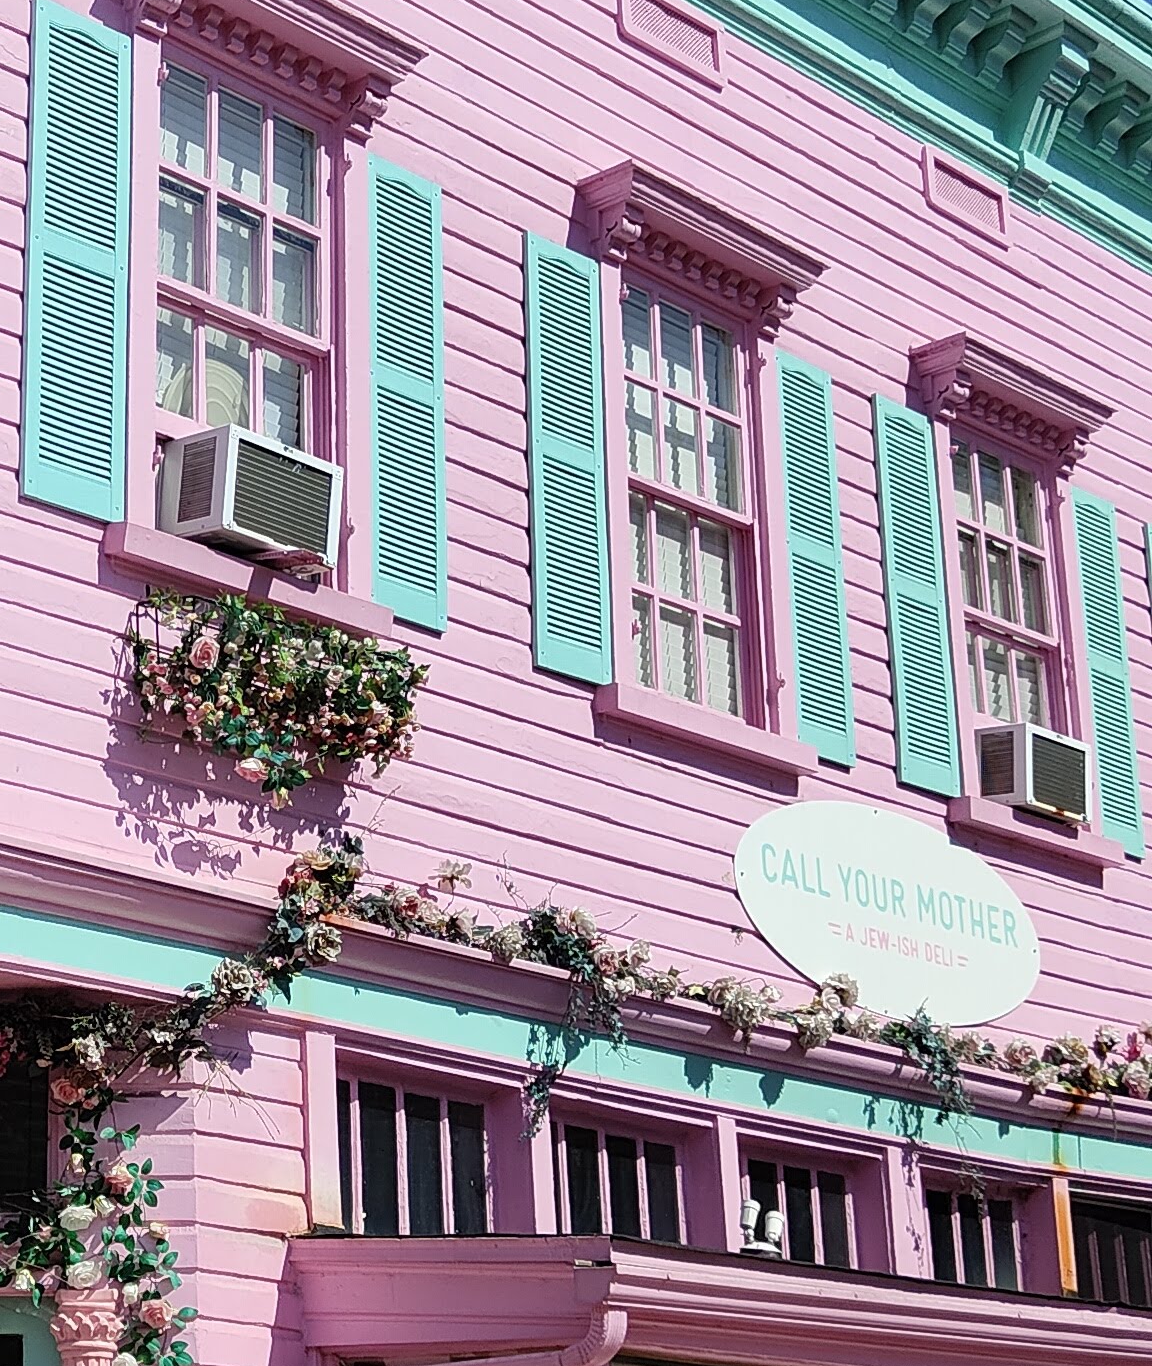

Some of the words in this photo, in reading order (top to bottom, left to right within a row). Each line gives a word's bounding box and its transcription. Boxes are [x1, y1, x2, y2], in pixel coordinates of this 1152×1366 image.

[761, 843, 831, 898] CALL
[837, 863, 906, 918] YOUR
[917, 884, 1019, 948] MOTHER
[845, 923, 855, 942] A
[860, 927, 919, 958] JEW-ISH
[925, 942, 953, 967] DELI
